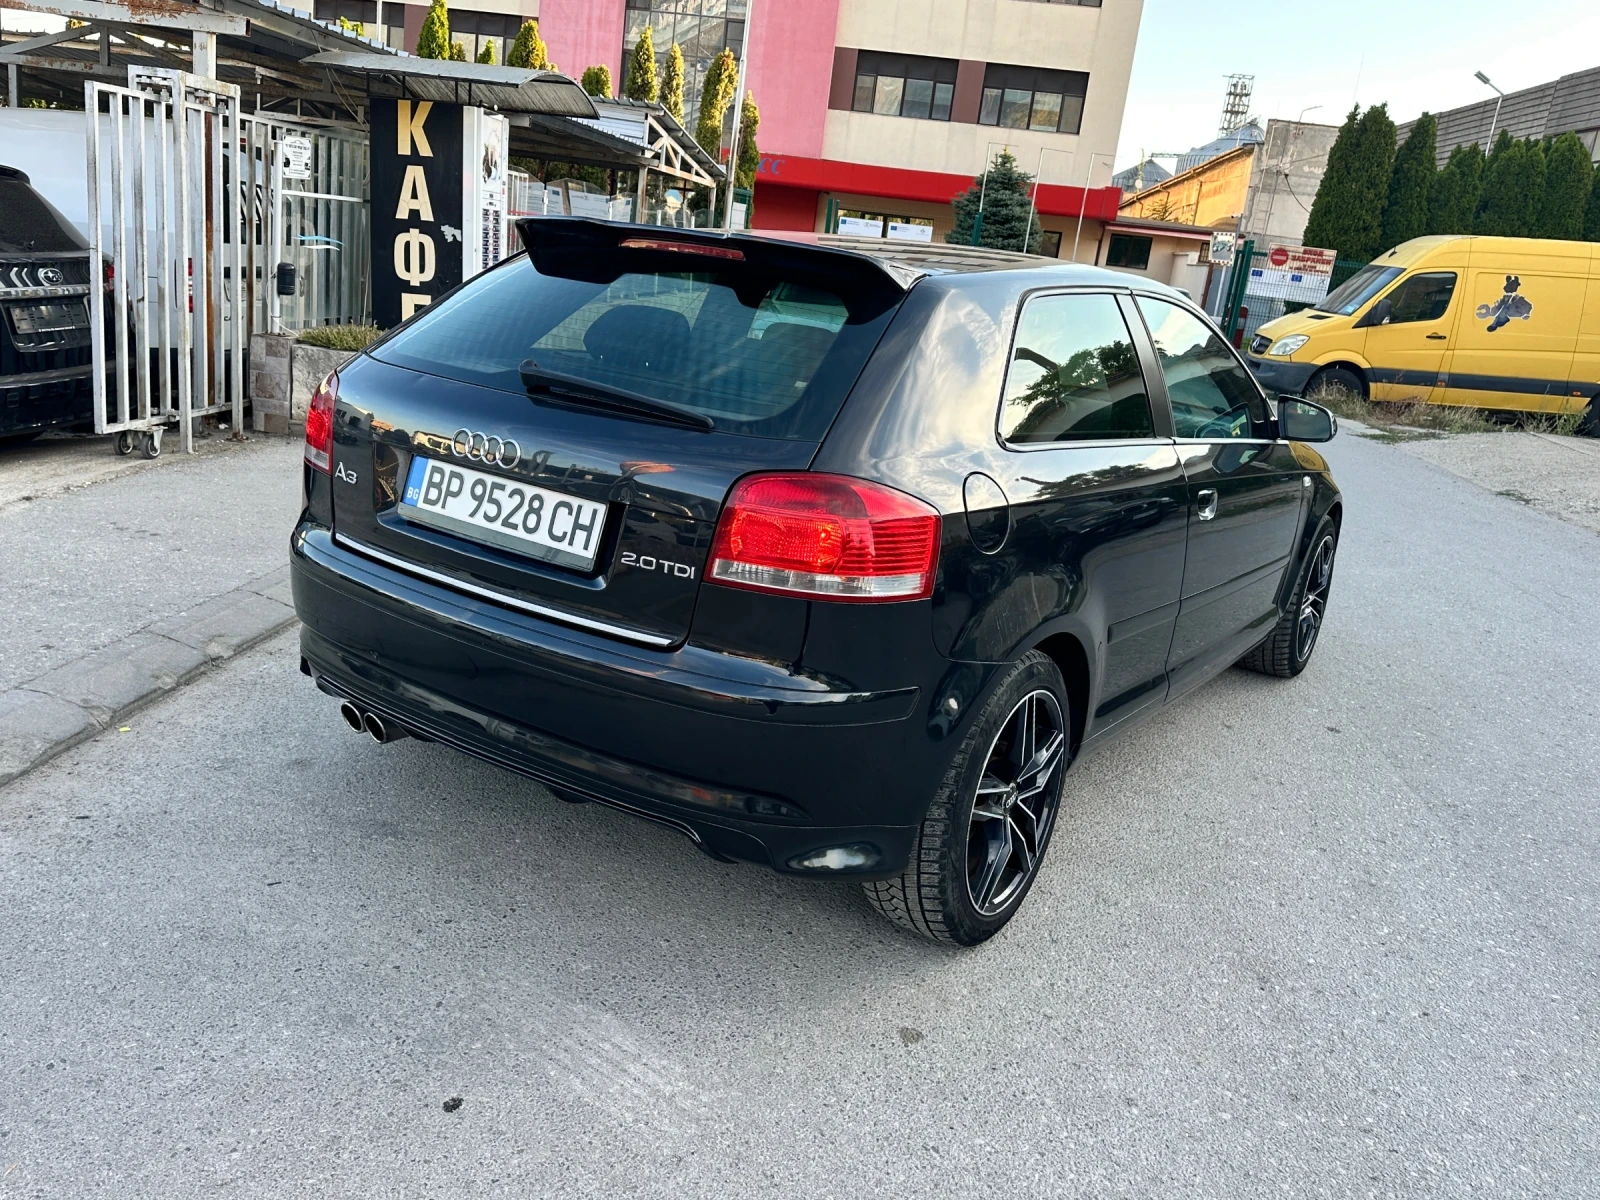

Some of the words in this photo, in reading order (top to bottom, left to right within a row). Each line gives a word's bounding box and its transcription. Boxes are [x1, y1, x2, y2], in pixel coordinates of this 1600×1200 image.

[334, 462, 358, 484] A3
[407, 486, 420, 499] BG
[422, 465, 464, 509] BP
[468, 478, 545, 535] 9528
[547, 500, 599, 551] CH
[620, 552, 656, 570] 2.0
[659, 560, 696, 579] TDI
